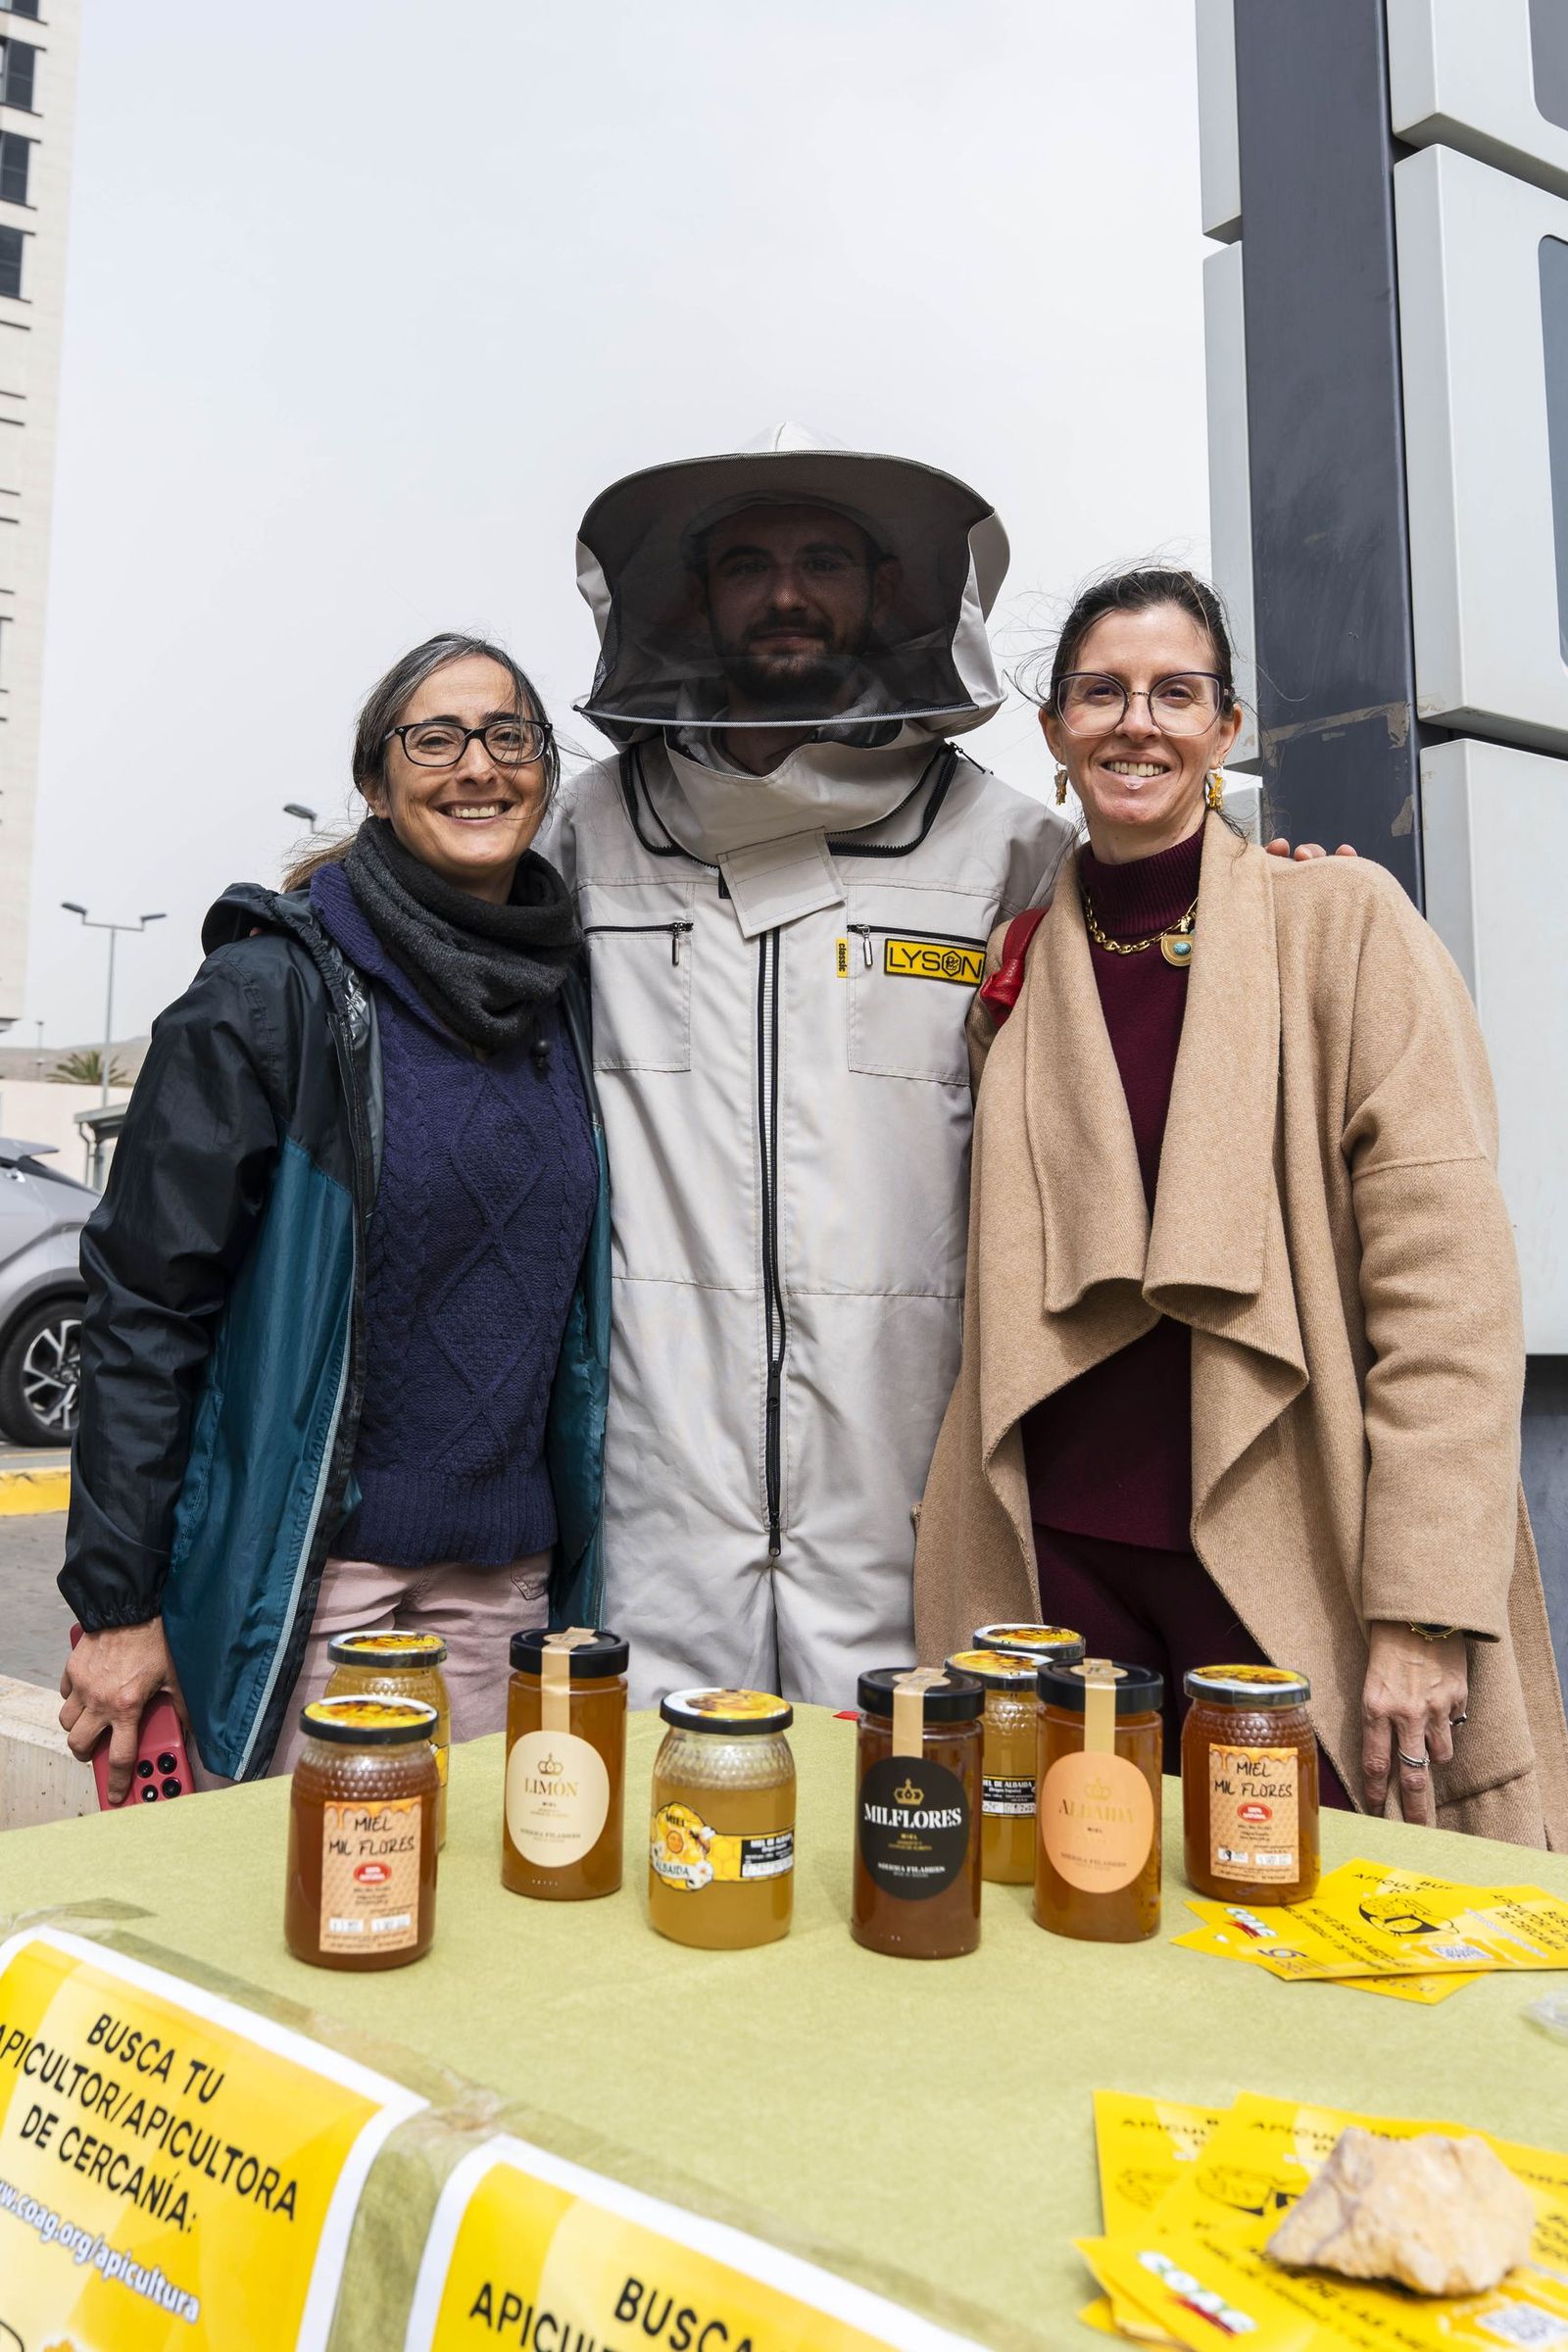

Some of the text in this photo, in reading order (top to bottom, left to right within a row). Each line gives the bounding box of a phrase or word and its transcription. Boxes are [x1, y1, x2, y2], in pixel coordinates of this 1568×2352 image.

[838, 943, 848, 972] classic
[1237, 1761, 1271, 1777] MIEL
[524, 1777, 578, 1797] LIMÓN
[1214, 1779, 1293, 1797] MIL FLORES
[354, 1815, 393, 1832] MIEL
[666, 1812, 685, 1828] MIEL
[863, 1802, 962, 1830] MILFLORES
[328, 1836, 415, 1856] MIL FLORES
[655, 1858, 690, 1876] ALBAIDA
[87, 2013, 226, 2104] BUSCA TU
[20, 2104, 197, 2233] DE CERCANÍA:
[614, 2277, 753, 2352] BUSC
